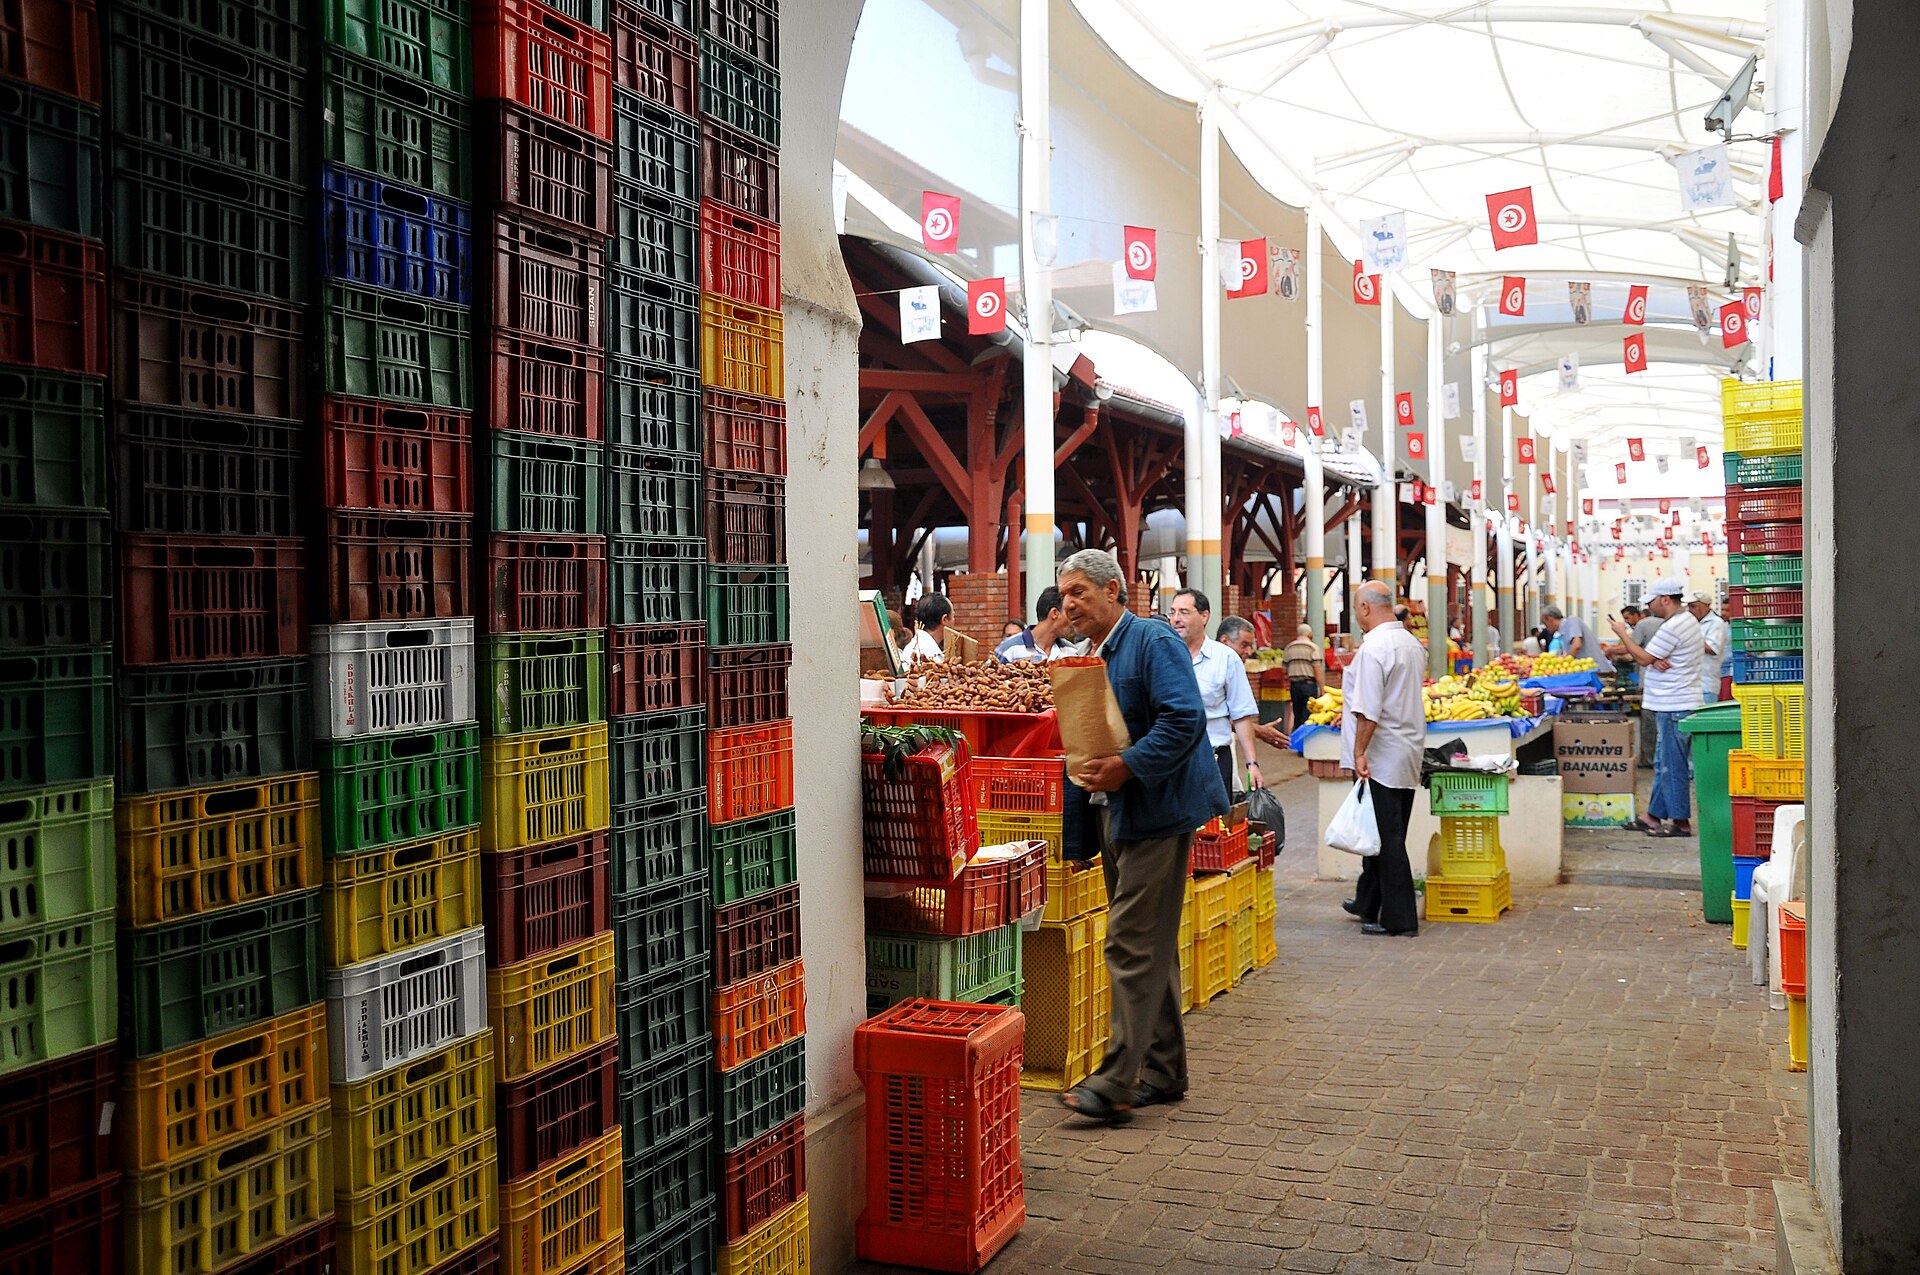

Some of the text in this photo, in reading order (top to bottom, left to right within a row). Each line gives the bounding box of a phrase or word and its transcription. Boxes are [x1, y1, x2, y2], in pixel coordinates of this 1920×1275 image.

[1558, 745, 1624, 756] BANANAS
[1562, 761, 1628, 772] BANANAS
[361, 1000, 369, 1055] EDDAKHLA
